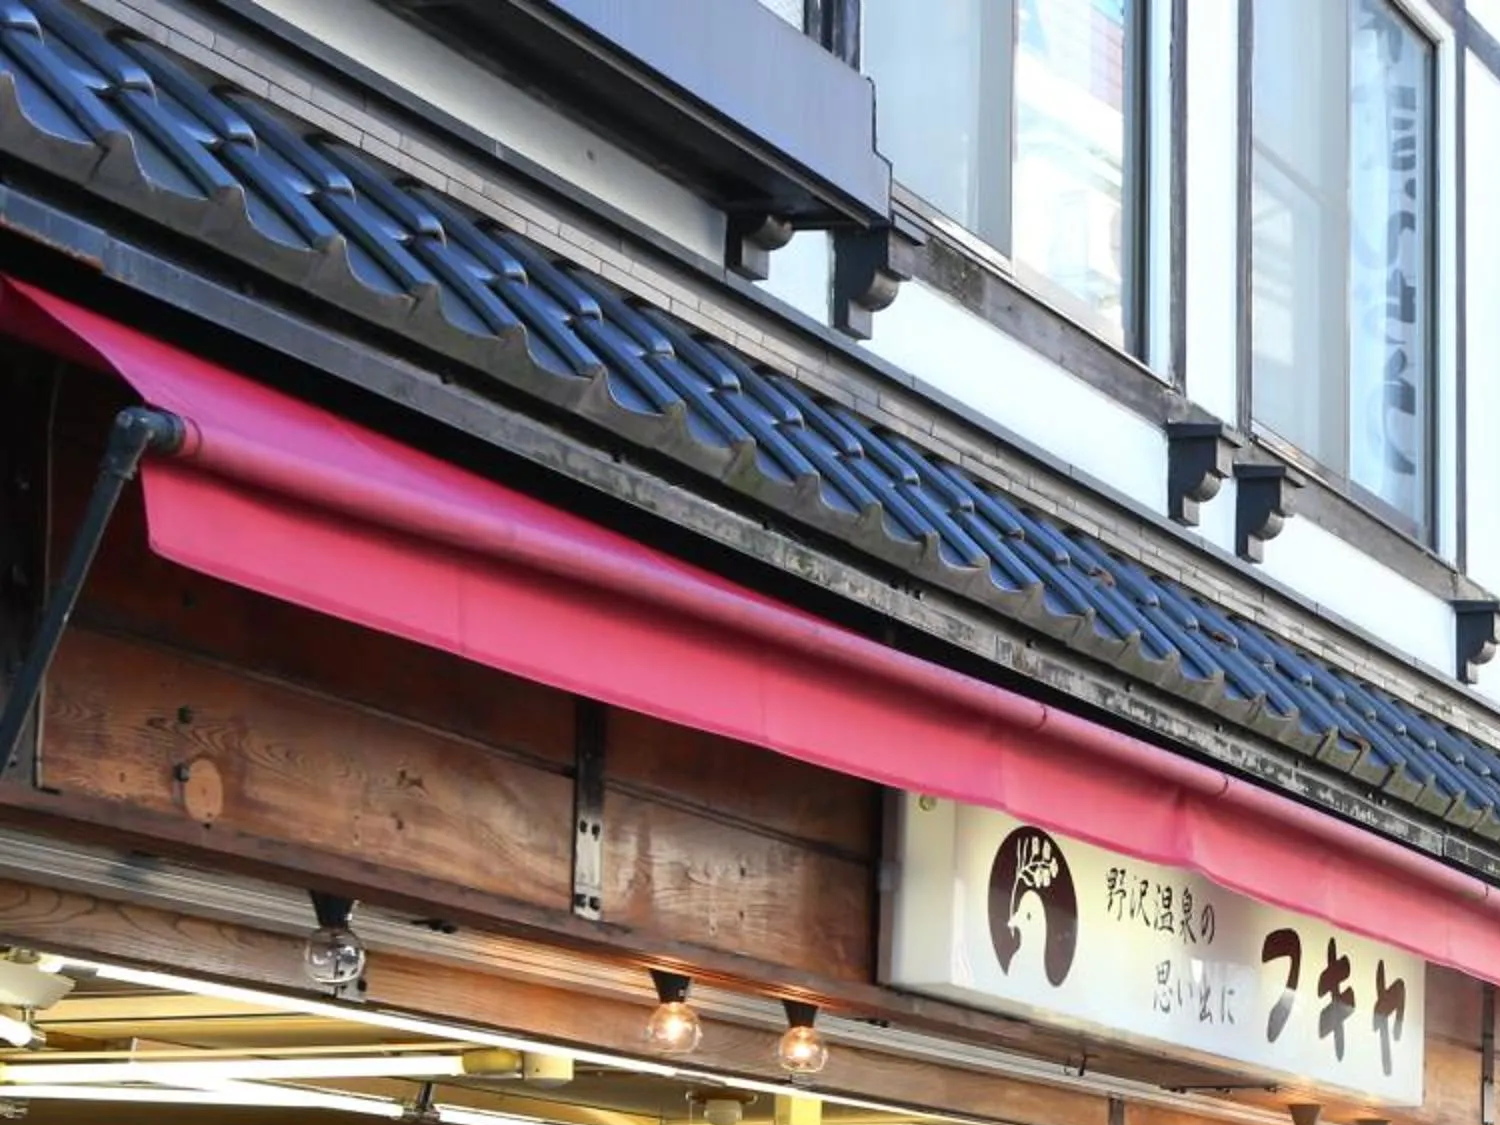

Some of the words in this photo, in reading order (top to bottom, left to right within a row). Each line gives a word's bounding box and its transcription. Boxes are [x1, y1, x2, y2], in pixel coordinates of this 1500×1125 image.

[1104, 866, 1216, 945] 野沢温泉の
[1152, 958, 1236, 1026] 思い出に
[1260, 927, 1407, 1077] フキヤ
